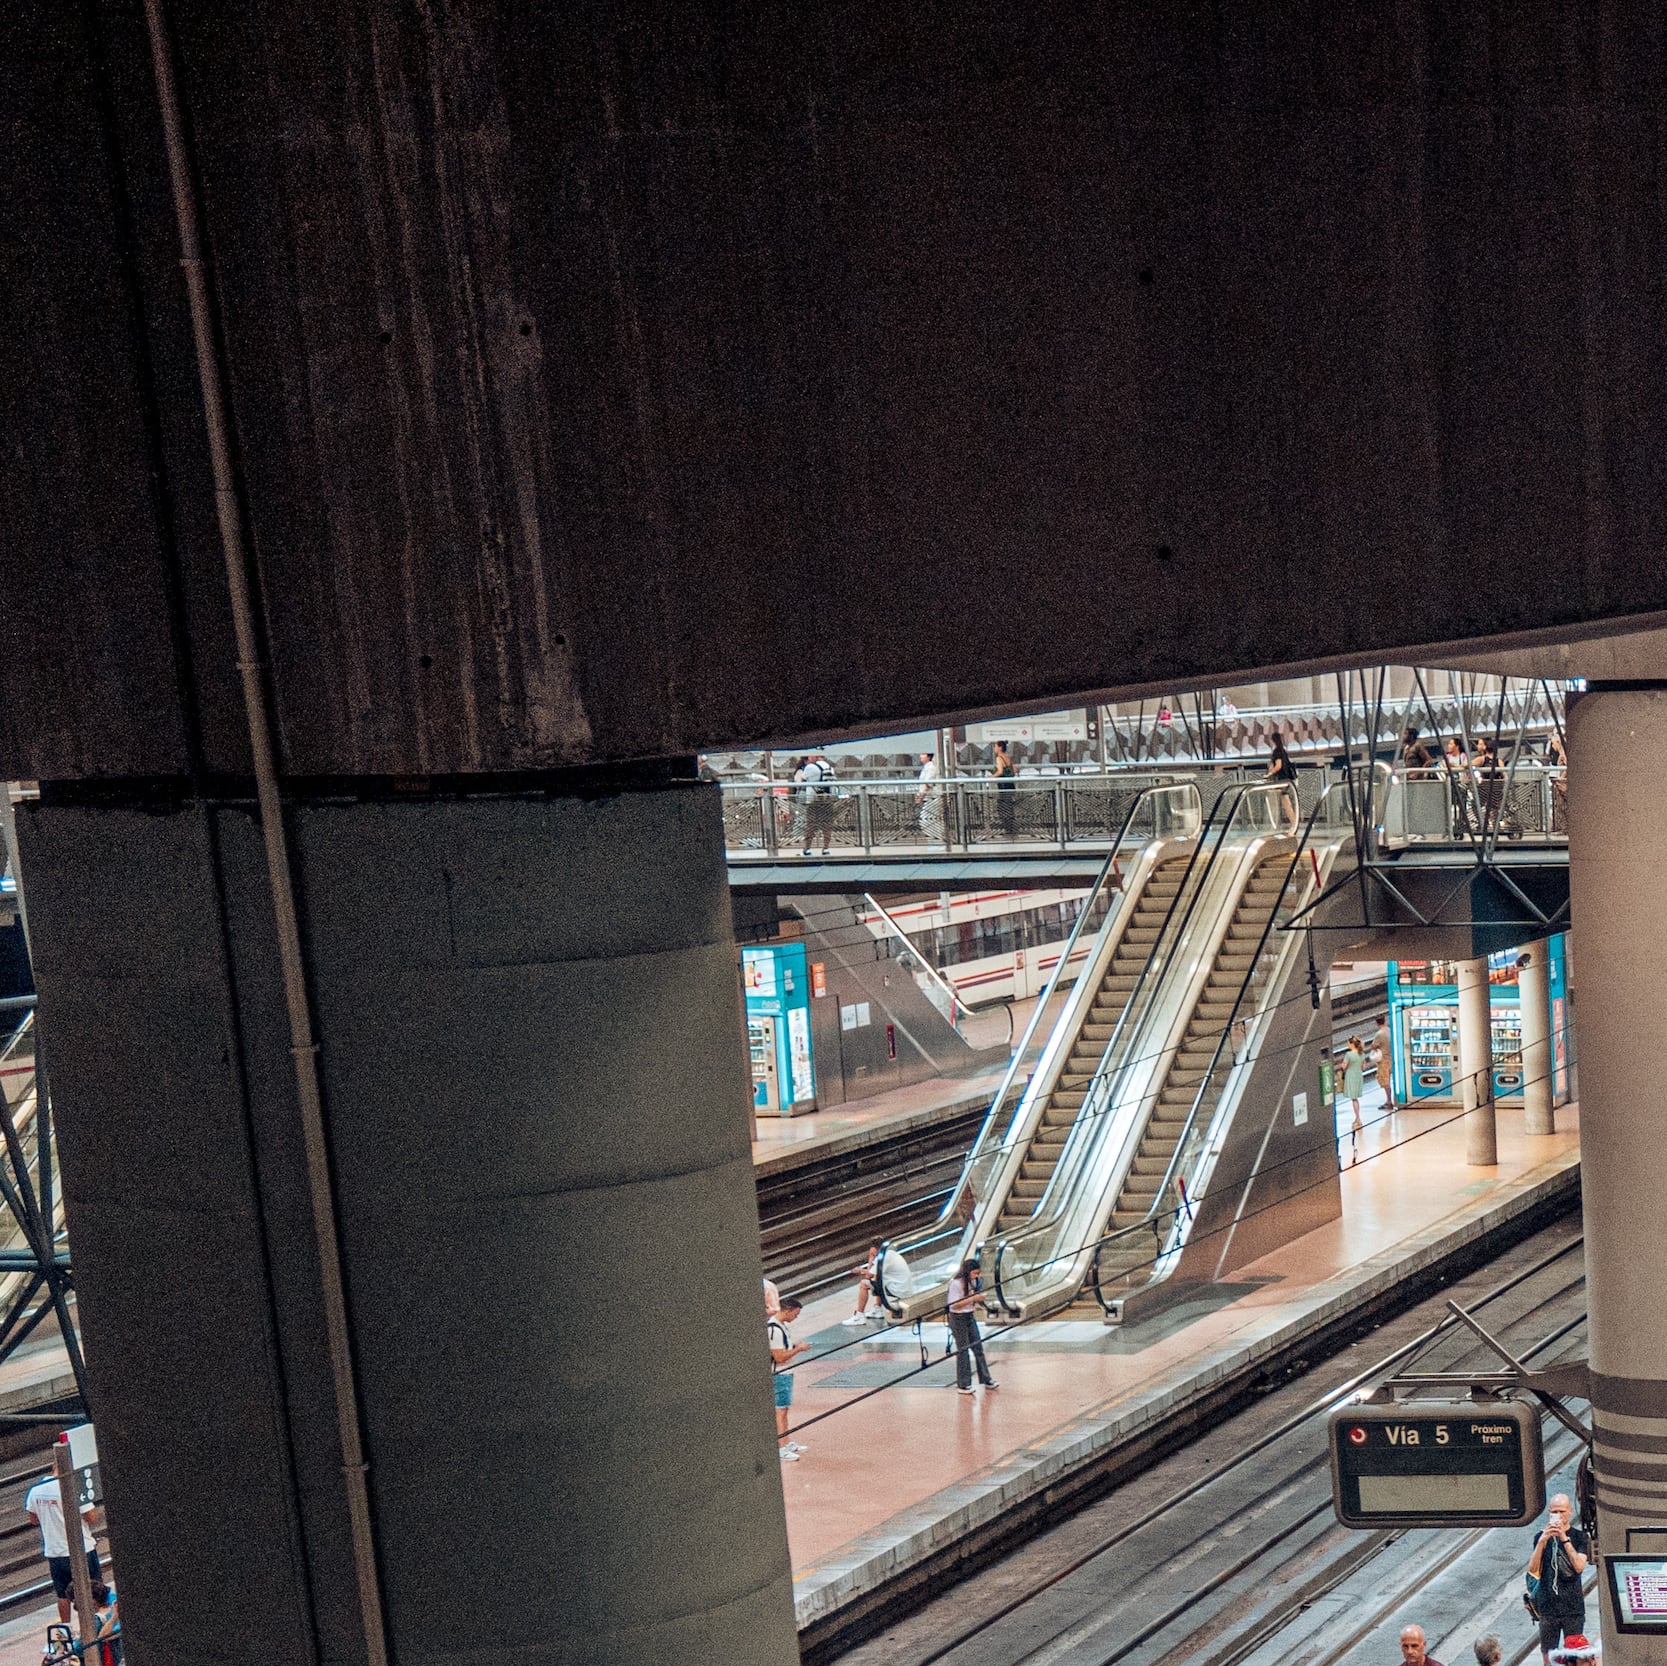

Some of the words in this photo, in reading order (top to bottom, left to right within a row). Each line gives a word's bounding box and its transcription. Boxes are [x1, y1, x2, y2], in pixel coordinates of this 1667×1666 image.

[1385, 1425, 1420, 1445] Vía
[1436, 1425, 1450, 1445] 5
[1471, 1424, 1512, 1435] Próximo
[1482, 1435, 1503, 1444] tren
